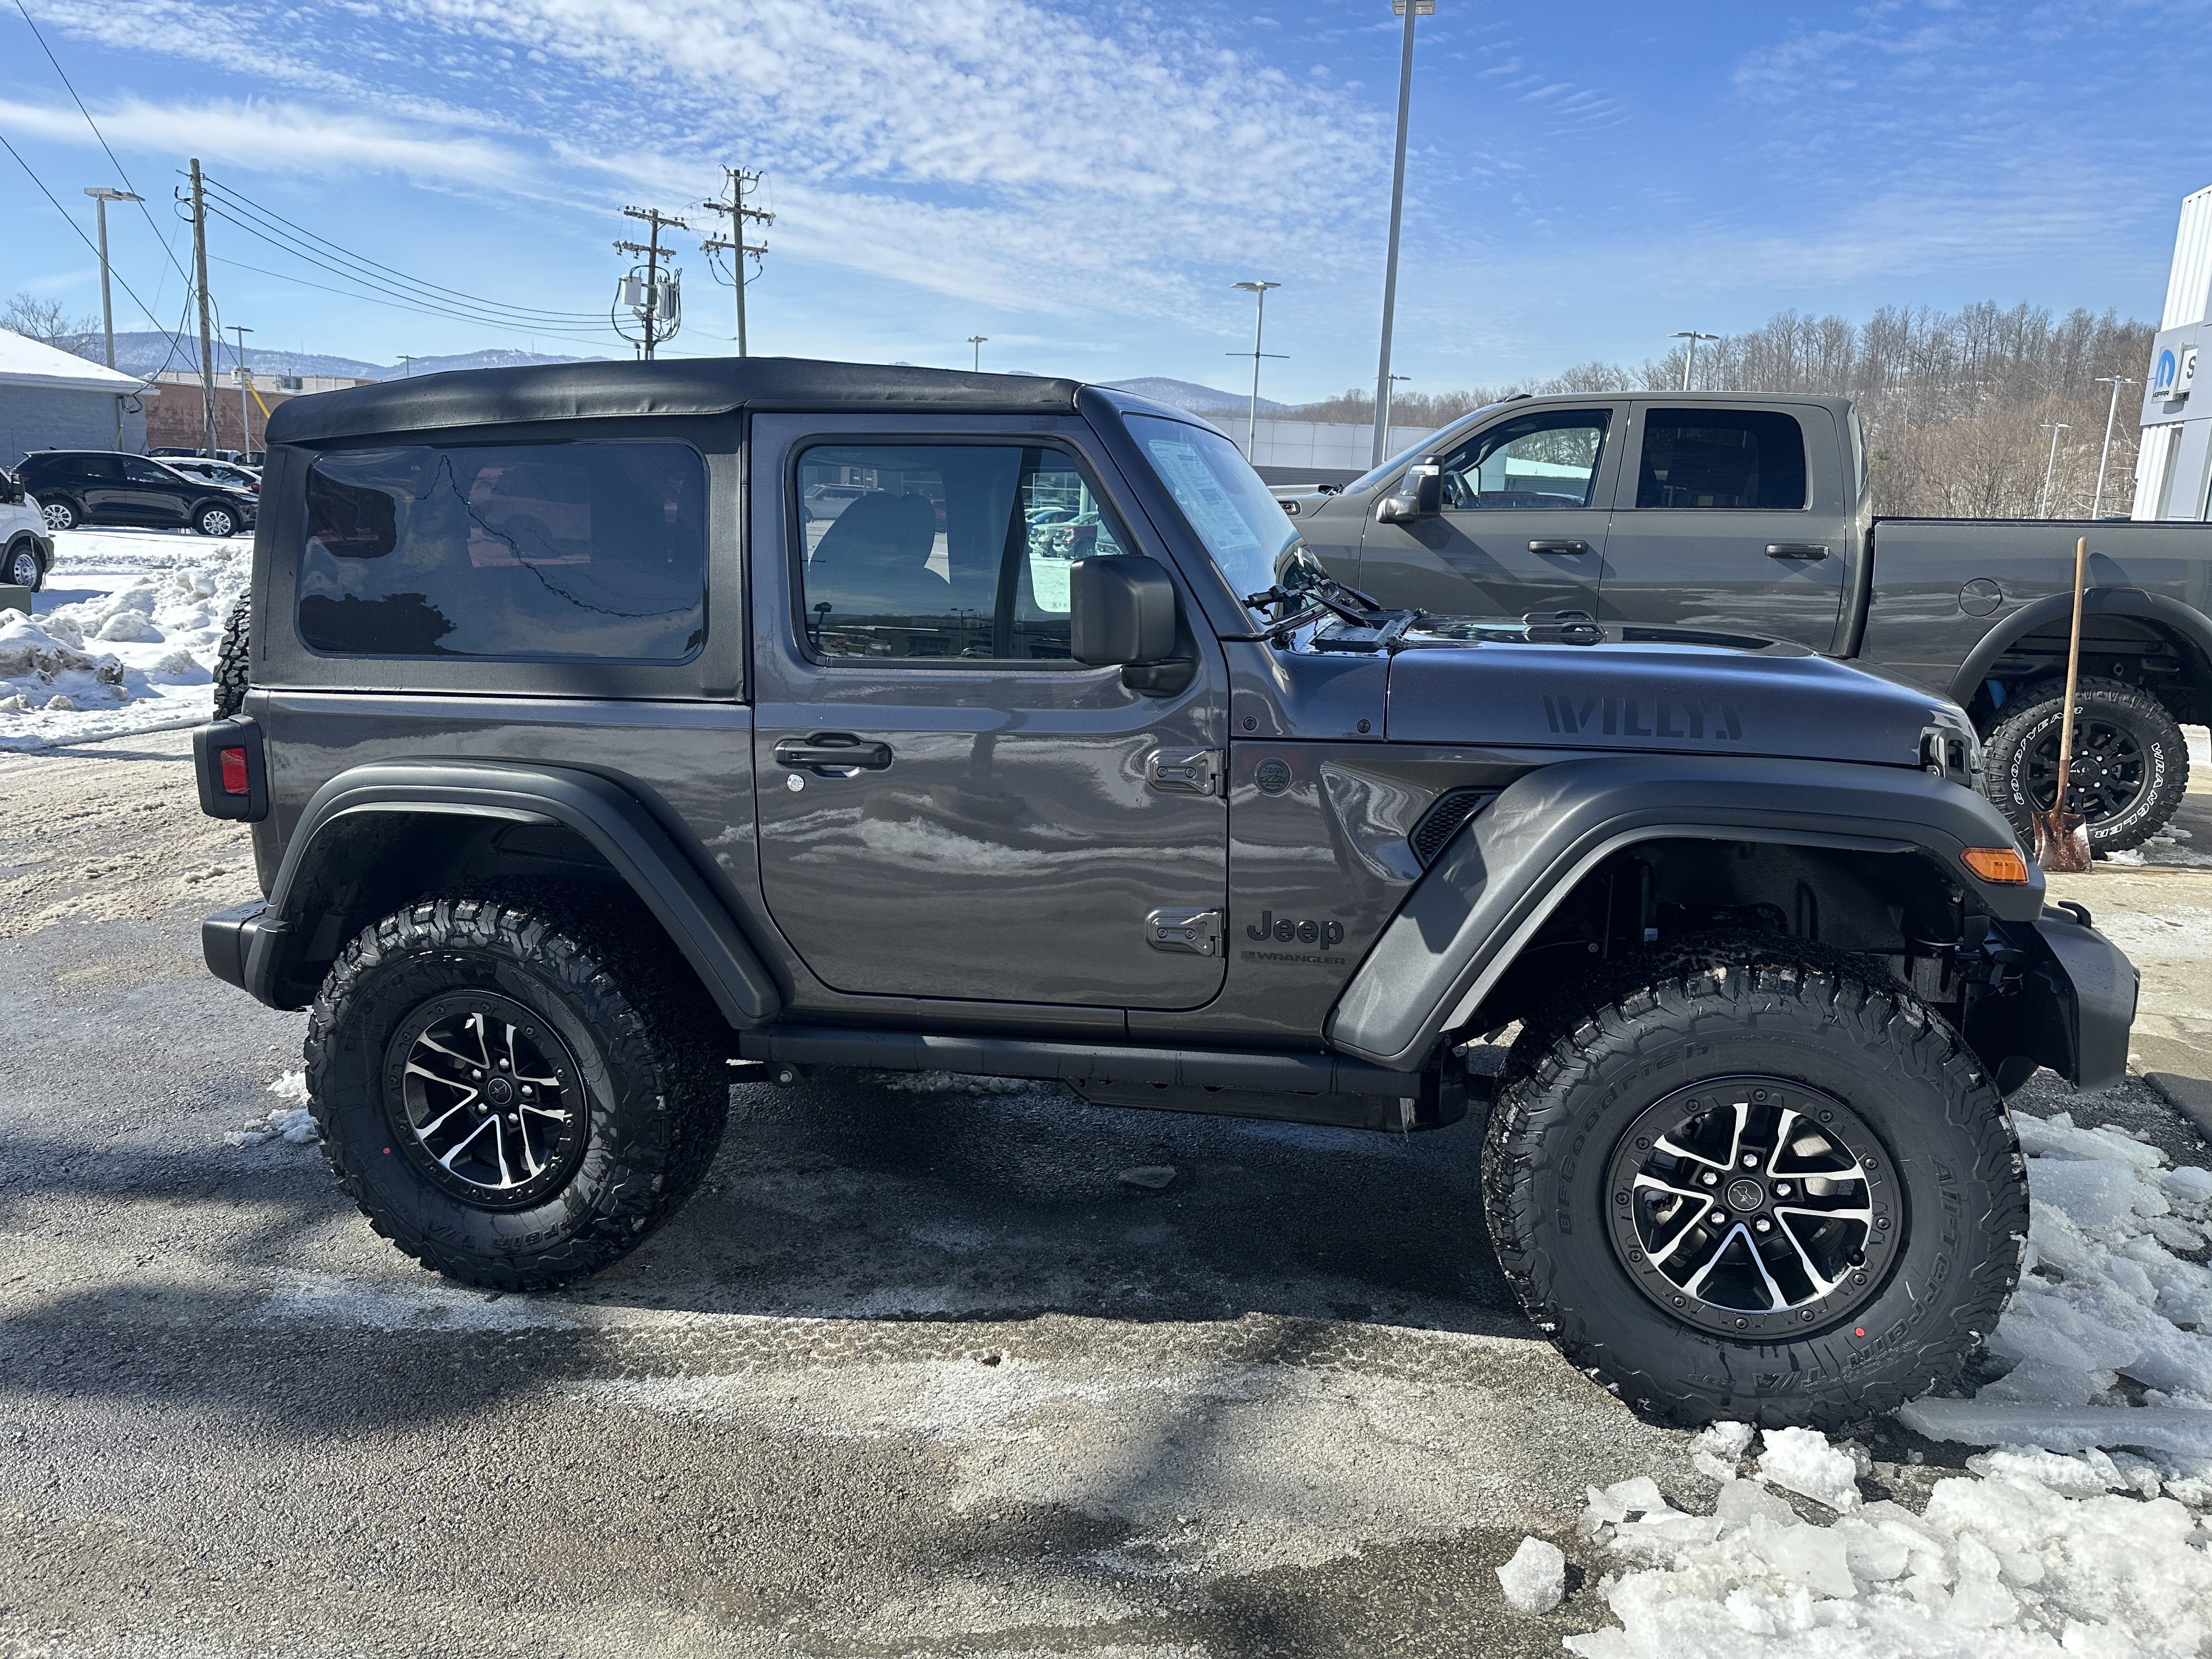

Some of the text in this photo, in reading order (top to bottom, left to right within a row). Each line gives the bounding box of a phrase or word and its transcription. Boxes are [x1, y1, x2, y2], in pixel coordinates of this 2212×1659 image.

[1541, 695, 1742, 740] WILLYS
[2095, 742, 2165, 839] WRANGLER
[1246, 910, 1344, 950] Jeep
[1256, 951, 1346, 965] WRANGLER
[1555, 1042, 1709, 1235] BFGoodrich
